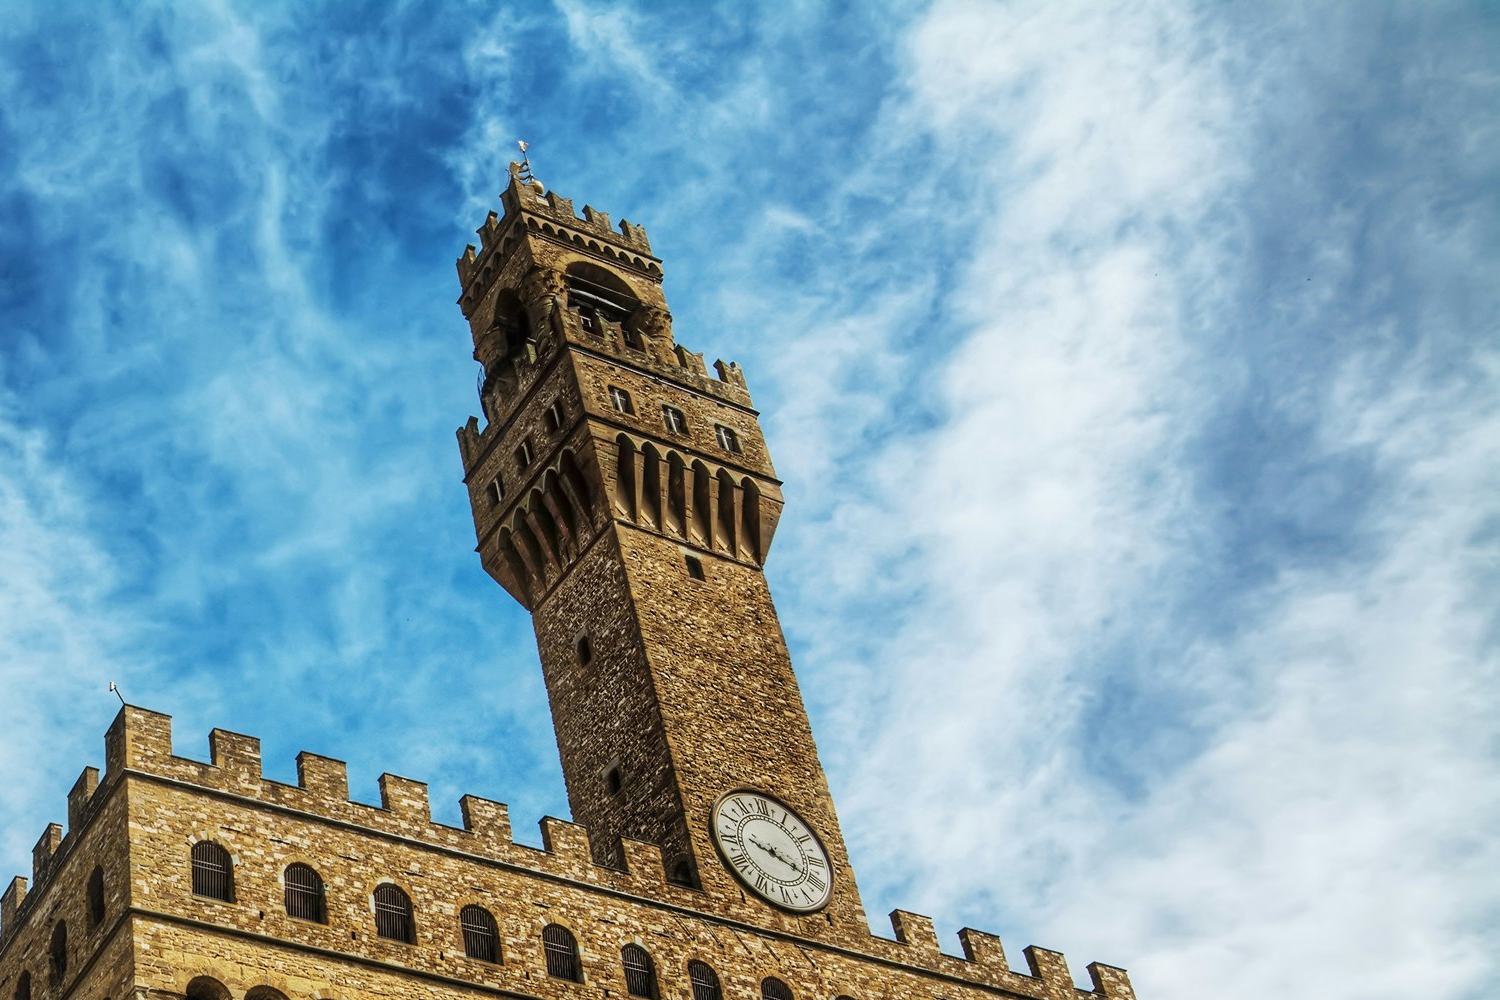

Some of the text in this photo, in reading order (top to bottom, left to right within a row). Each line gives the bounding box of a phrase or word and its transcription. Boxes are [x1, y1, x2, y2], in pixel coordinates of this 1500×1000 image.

[732, 798, 751, 816] XI
[754, 798, 770, 817] XII
[720, 809, 738, 826] X
[780, 812, 788, 825] I
[720, 830, 738, 845] IX
[797, 834, 811, 844] II
[731, 854, 749, 873] VIII
[807, 856, 825, 869] III
[755, 873, 769, 895] VII
[779, 886, 794, 905] VI
[800, 887, 814, 904] V
